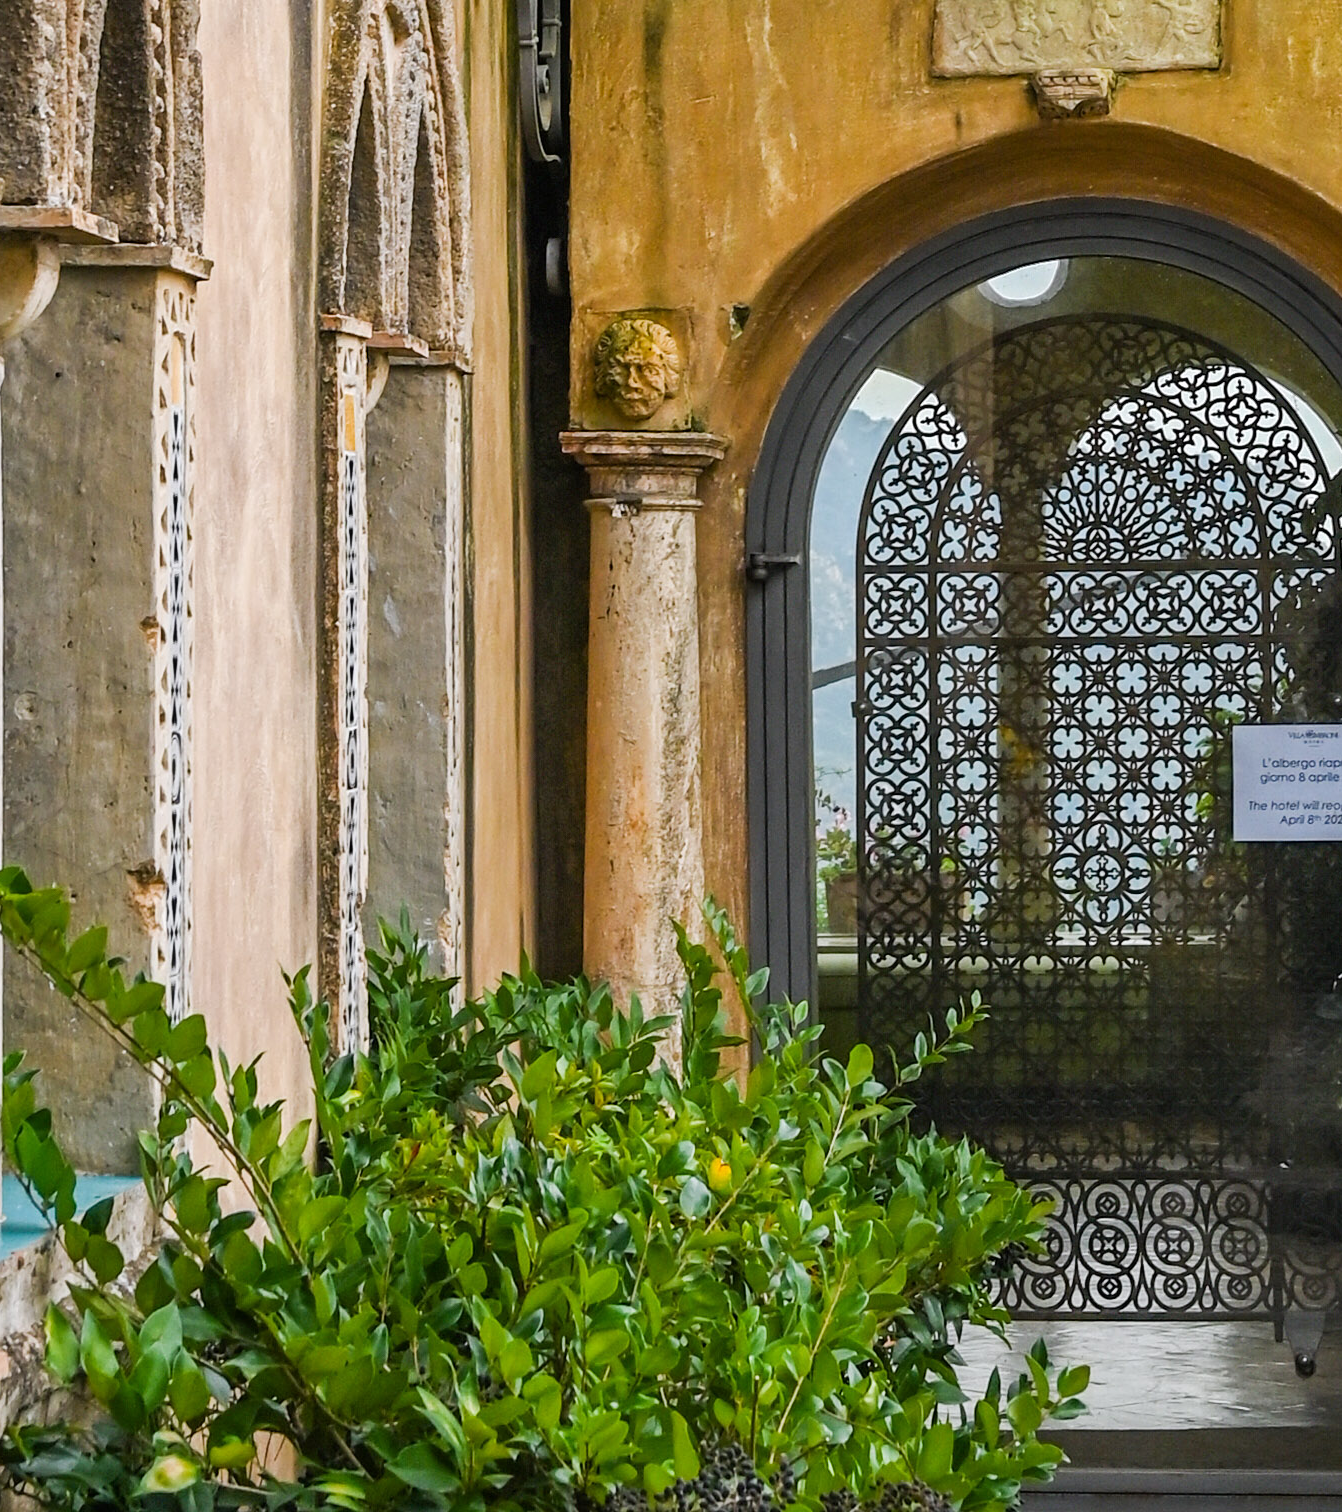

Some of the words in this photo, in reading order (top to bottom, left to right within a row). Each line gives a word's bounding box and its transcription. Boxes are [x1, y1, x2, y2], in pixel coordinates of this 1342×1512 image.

[1262, 758, 1316, 770] L'albergo
[1260, 772, 1296, 784] giorno
[1298, 772, 1306, 782] 8
[1308, 772, 1340, 783] aprile
[1249, 800, 1268, 811] The
[1271, 800, 1300, 811] hotel
[1302, 800, 1320, 810] will
[1279, 814, 1305, 826] April
